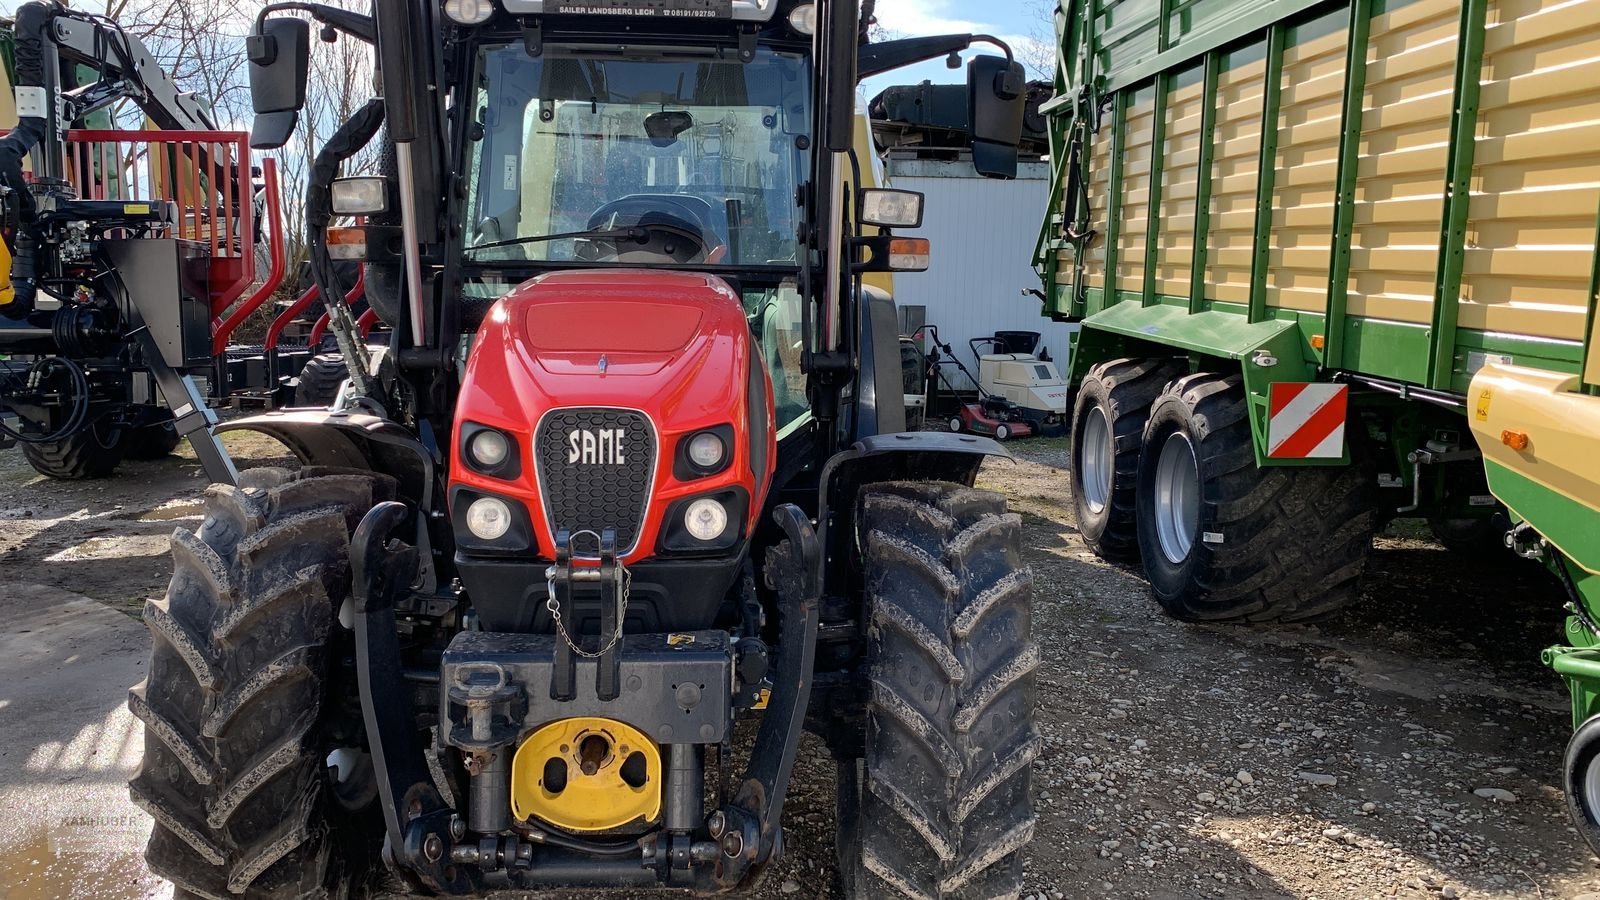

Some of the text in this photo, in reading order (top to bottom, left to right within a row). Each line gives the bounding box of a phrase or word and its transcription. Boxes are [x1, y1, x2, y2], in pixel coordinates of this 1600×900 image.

[559, 6, 586, 14] SAILER
[587, 7, 633, 15] LANDSBERG
[634, 8, 655, 16] LECH
[569, 428, 626, 465] SAME
